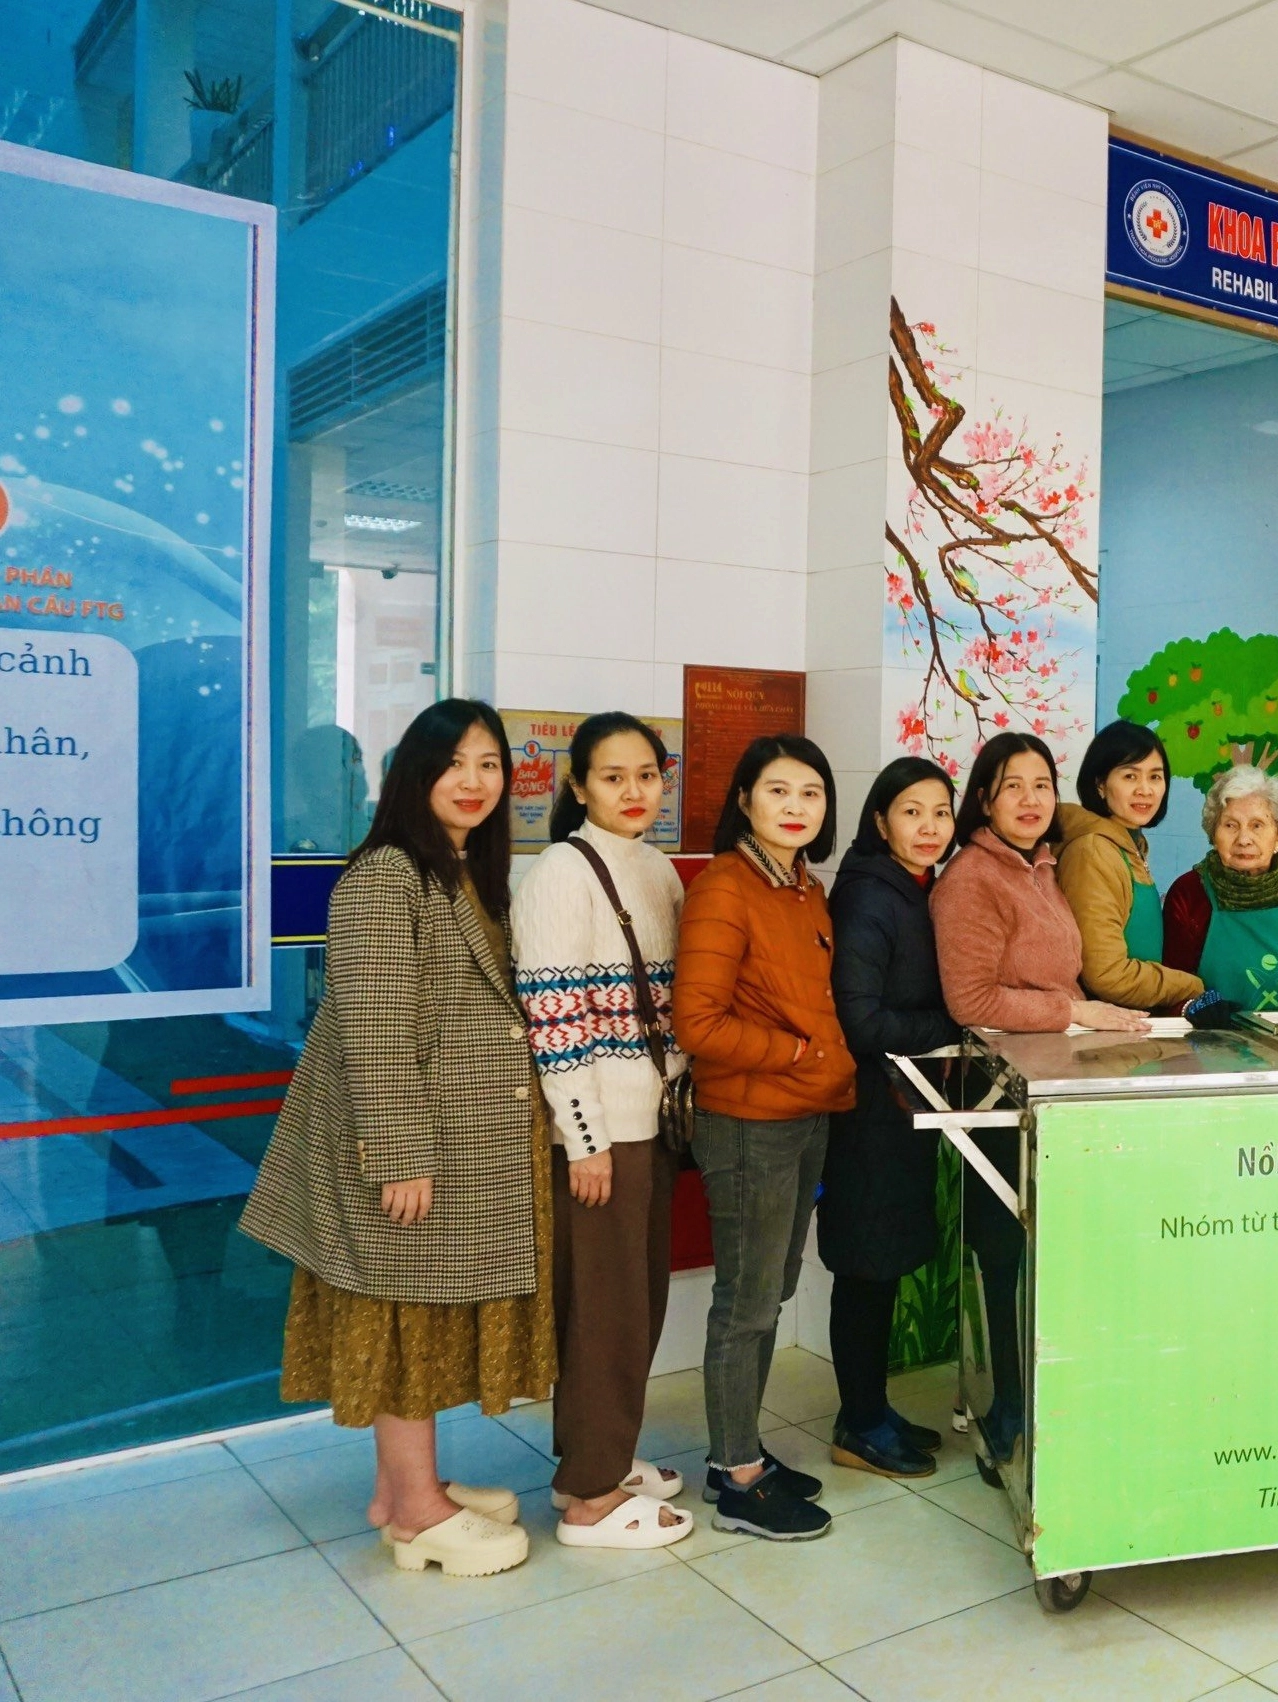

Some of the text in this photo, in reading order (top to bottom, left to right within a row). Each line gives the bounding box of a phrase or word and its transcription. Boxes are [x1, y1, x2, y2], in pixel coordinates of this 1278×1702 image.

[1207, 201, 1267, 264] KHOA
[81, 600, 125, 620] FTG
[0, 642, 92, 677] cảnh
[0, 727, 89, 760] hân,
[0, 807, 101, 844] hông
[1161, 1215, 1234, 1239] Nhóm
[1242, 1211, 1267, 1233] từ
